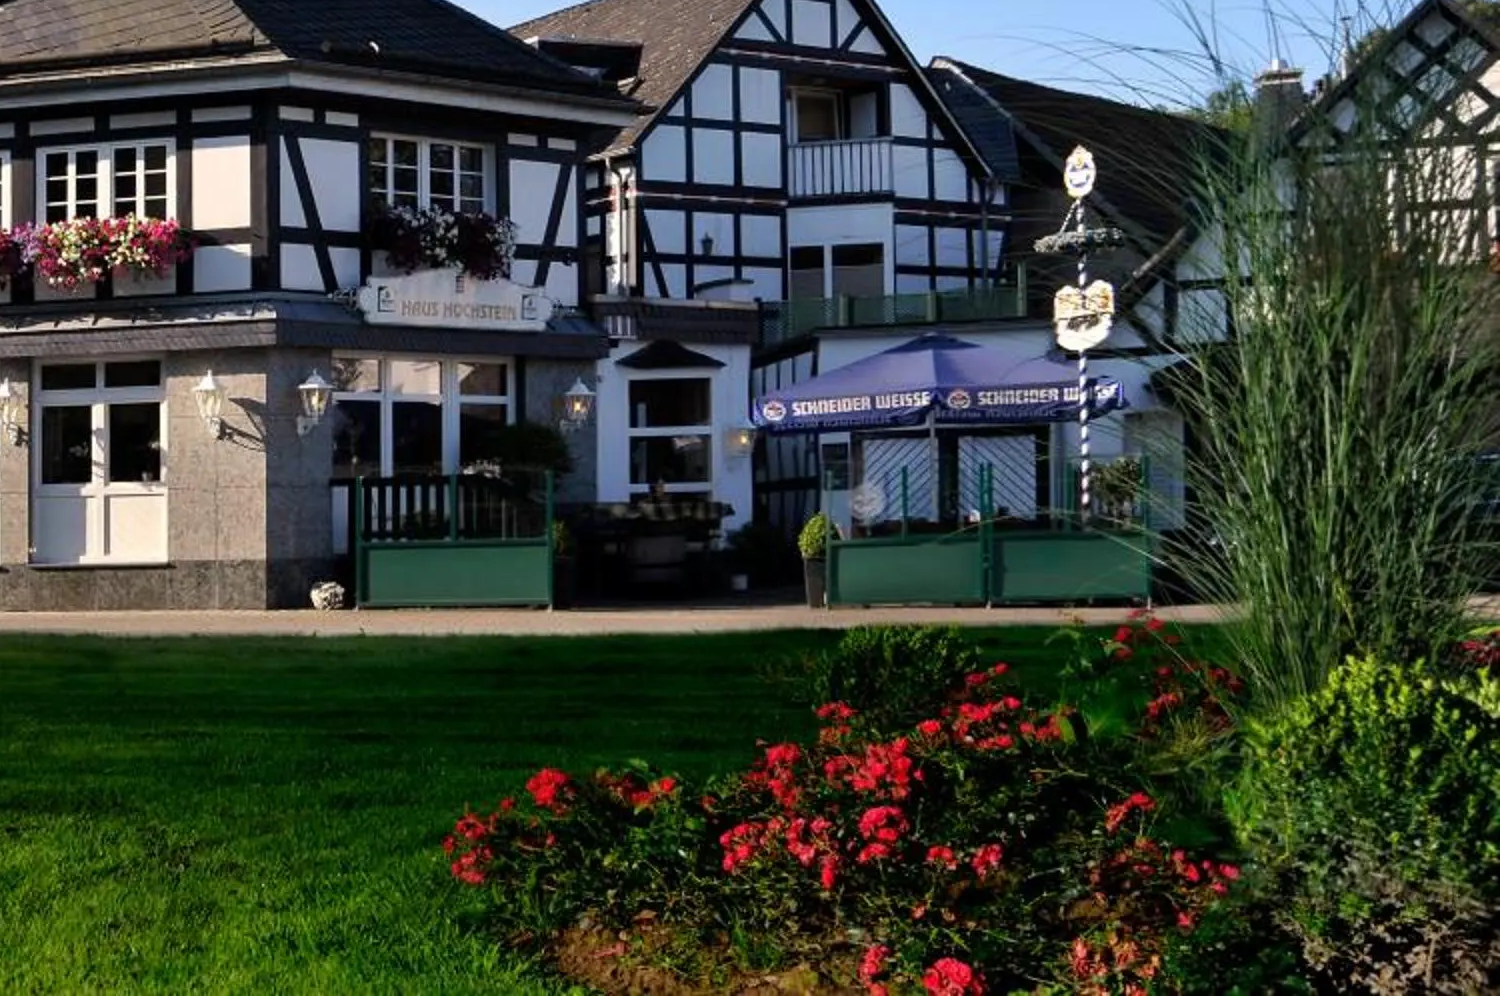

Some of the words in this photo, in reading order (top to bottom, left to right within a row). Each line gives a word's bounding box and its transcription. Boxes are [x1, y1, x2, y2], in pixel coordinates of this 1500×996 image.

[401, 299, 439, 318] HAUS
[791, 395, 872, 417] SCHNEIDER
[875, 391, 932, 409] WEISSE
[976, 386, 1060, 406] SCHNEIDER
